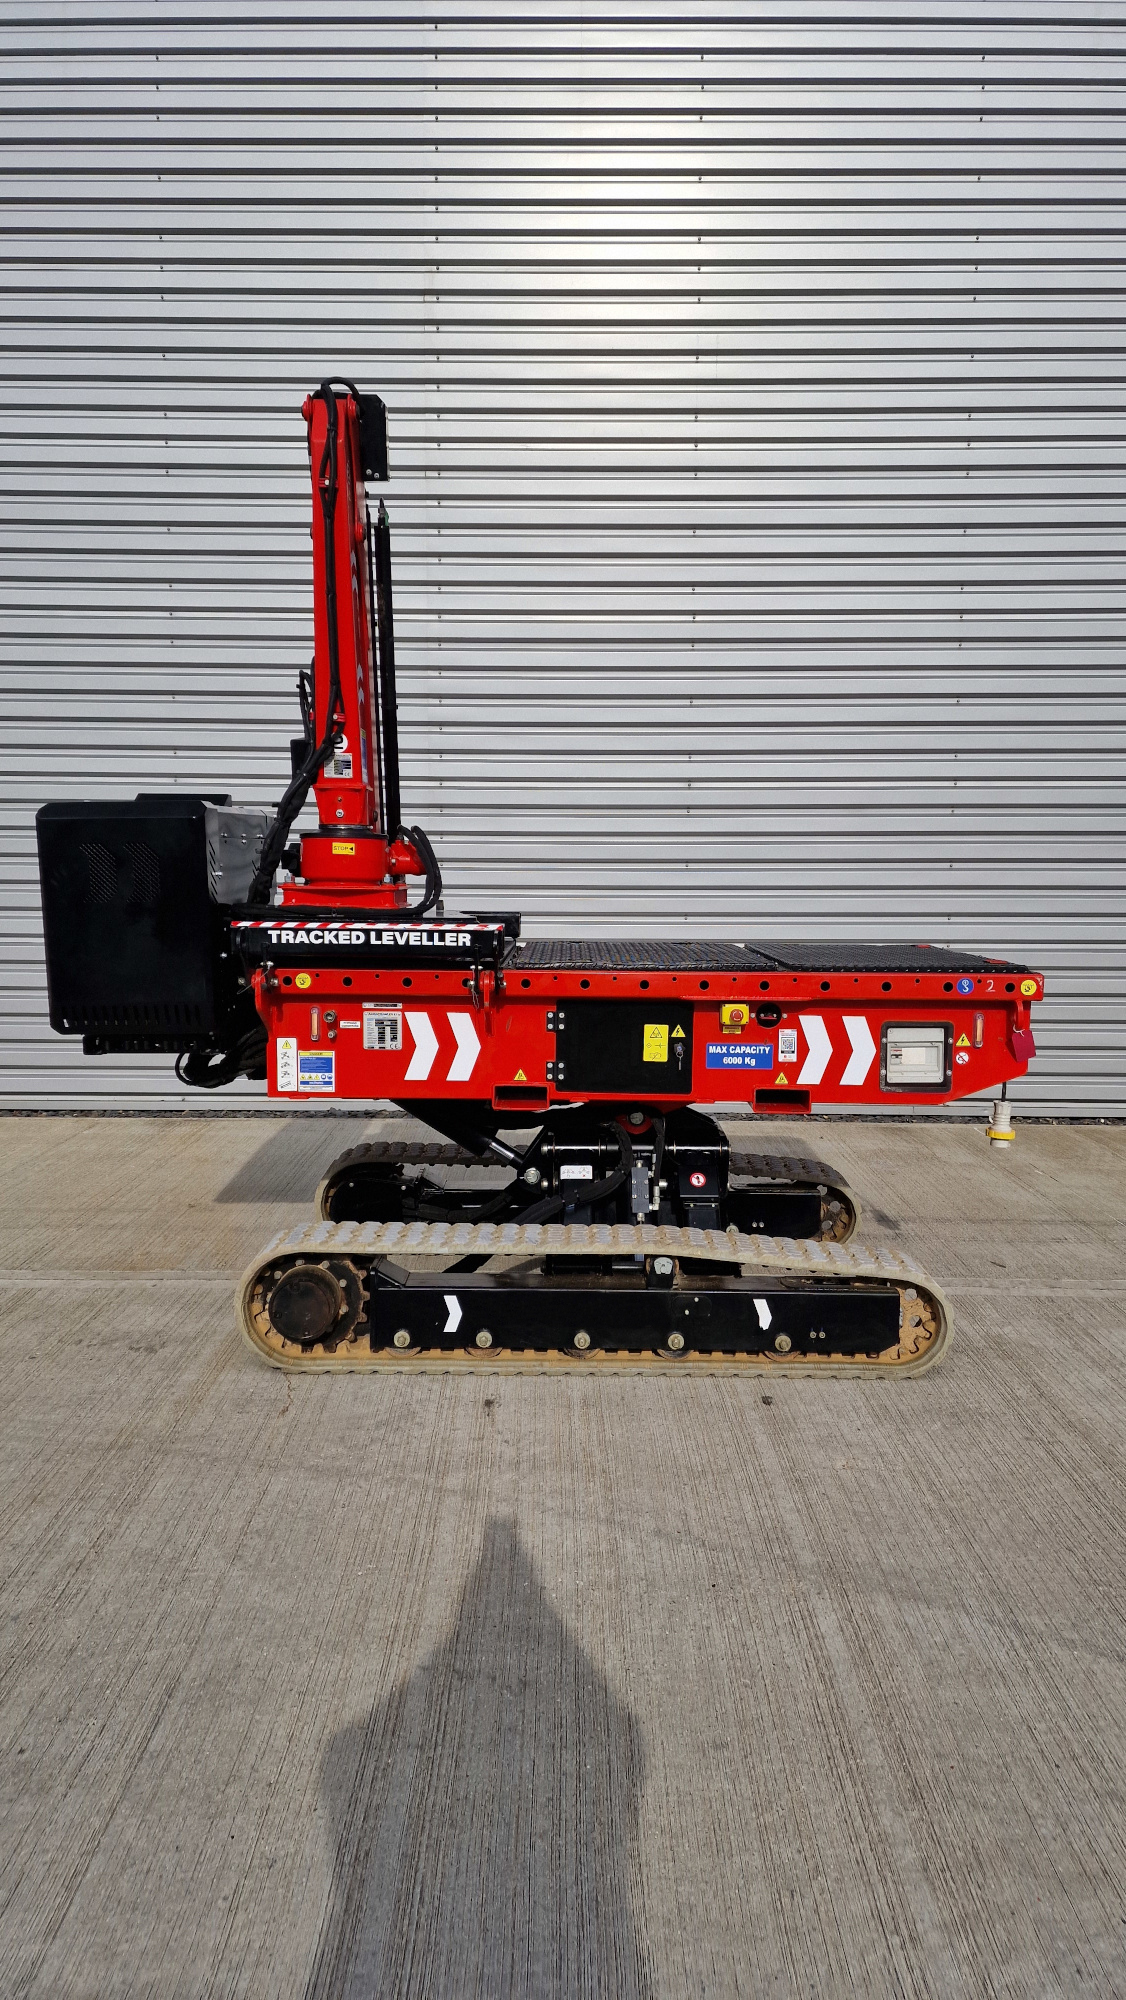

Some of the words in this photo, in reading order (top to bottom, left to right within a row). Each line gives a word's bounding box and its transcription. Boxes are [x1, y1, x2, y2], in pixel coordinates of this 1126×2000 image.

[267, 930, 366, 944] TRACKED
[370, 931, 472, 947] LEVELLER
[985, 979, 996, 992] 2
[708, 1046, 727, 1054] MAX
[729, 1046, 771, 1054] CAPACITY
[723, 1057, 743, 1065] 6000
[744, 1057, 756, 1066] Kg
